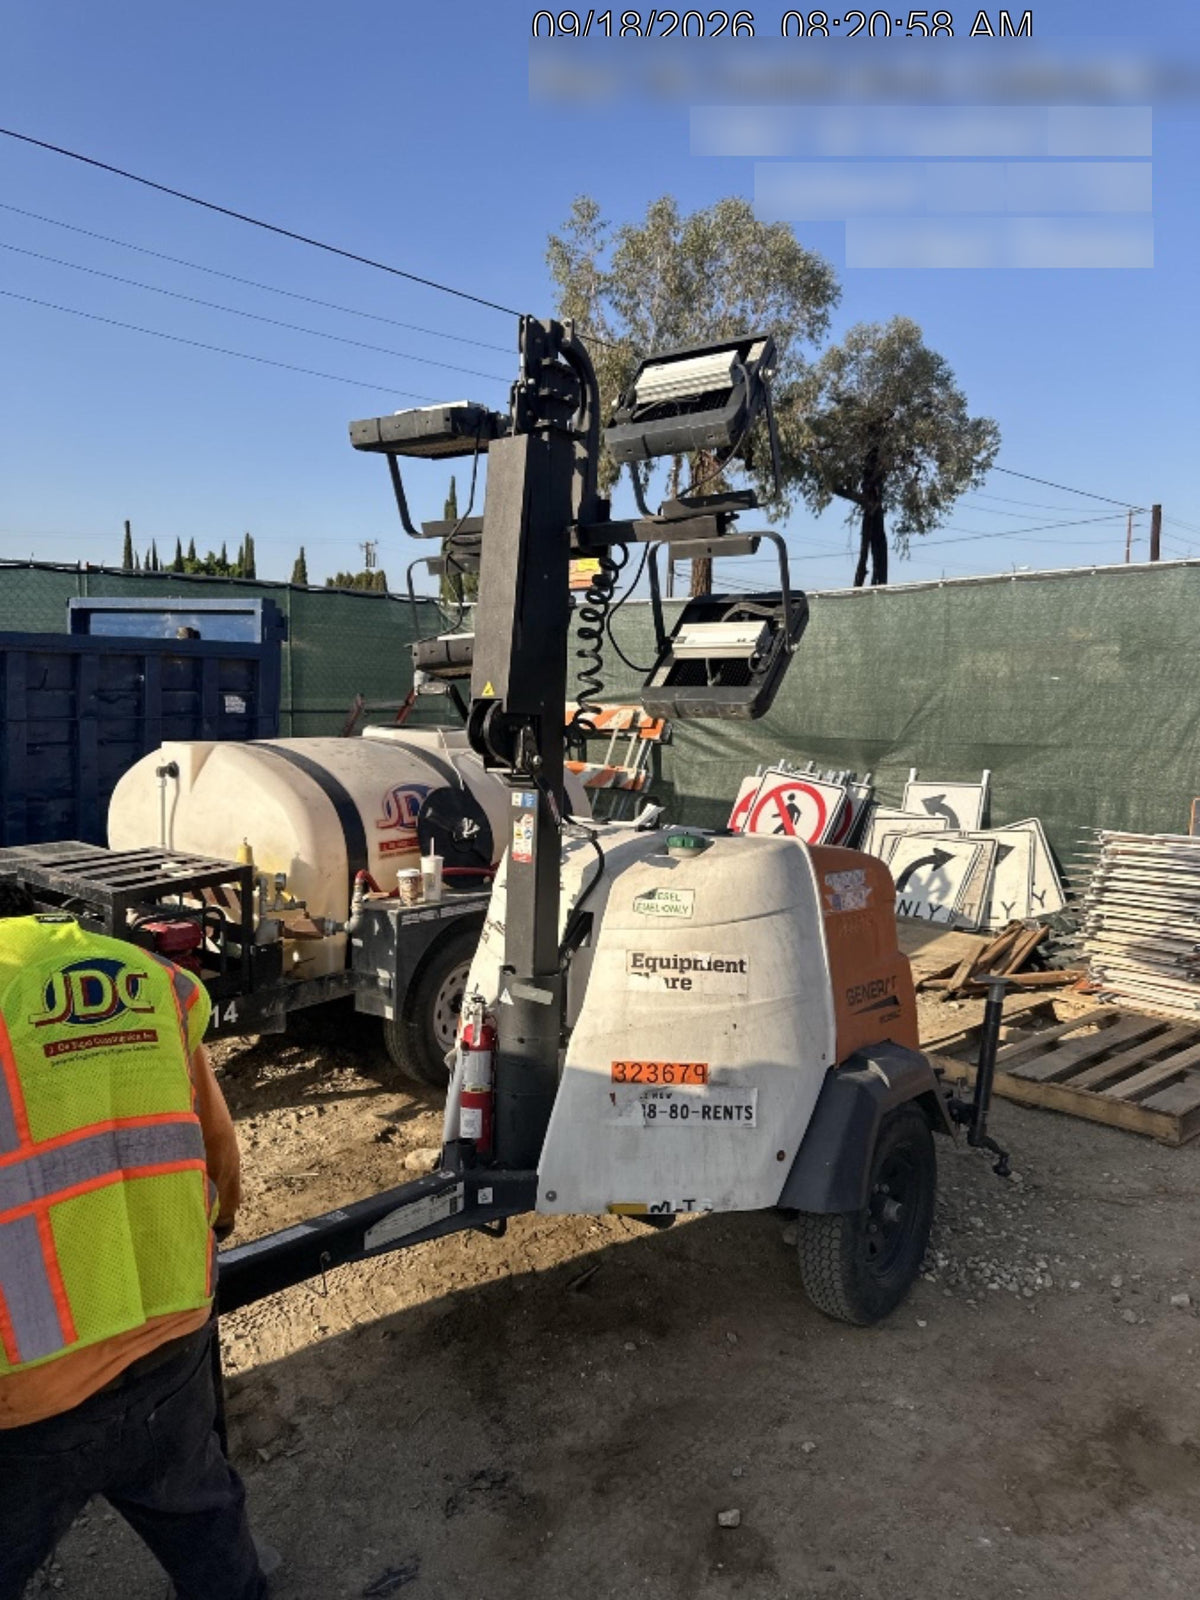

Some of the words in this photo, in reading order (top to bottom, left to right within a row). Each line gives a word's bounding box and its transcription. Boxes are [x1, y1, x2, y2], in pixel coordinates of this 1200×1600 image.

[897, 899, 943, 922] NLY
[988, 901, 1016, 920] LY
[28, 966, 155, 1028] JDC
[614, 1062, 706, 1084] 323679
